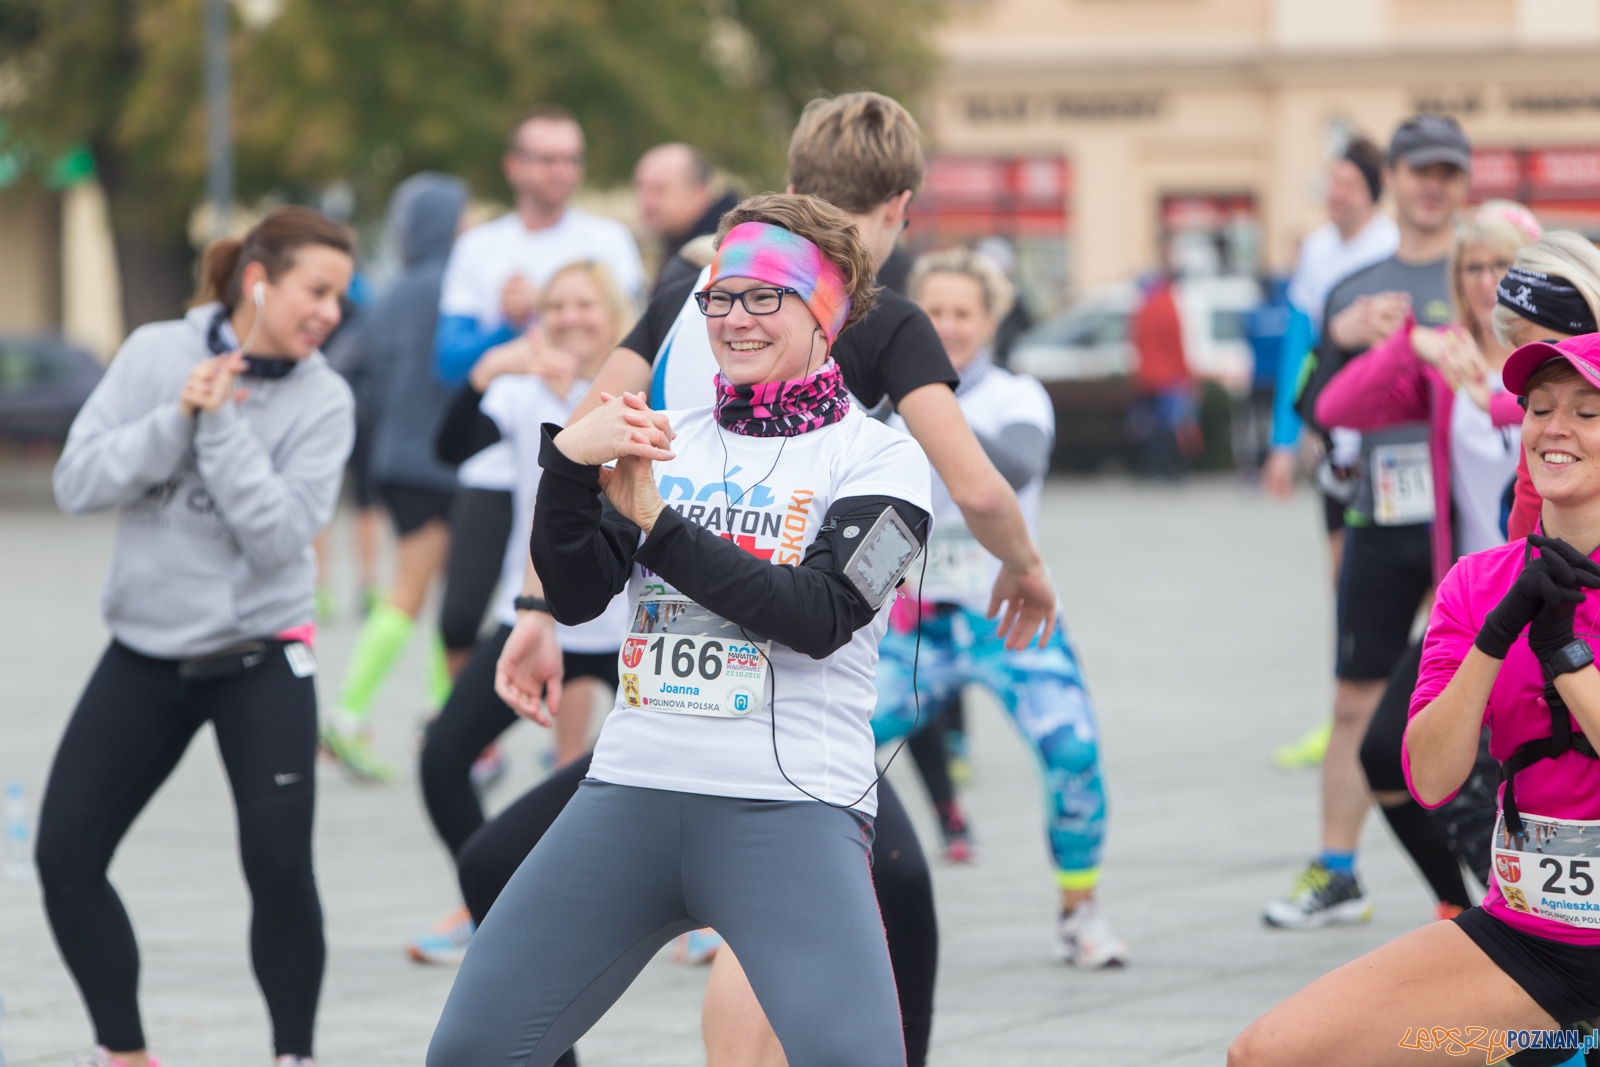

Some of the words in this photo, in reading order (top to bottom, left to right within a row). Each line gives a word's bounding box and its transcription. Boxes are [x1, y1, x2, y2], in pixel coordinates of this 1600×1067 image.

[649, 636, 724, 681] 166
[727, 652, 759, 662] MARATON
[725, 670, 761, 679] 23.10.2016
[659, 682, 700, 696] Joanna
[649, 698, 686, 709] POLINOVA
[687, 701, 721, 712] POLSKA
[1539, 857, 1595, 896] 25
[1541, 897, 1600, 911] Agnieszka
[1540, 909, 1581, 923] POLINOVA
